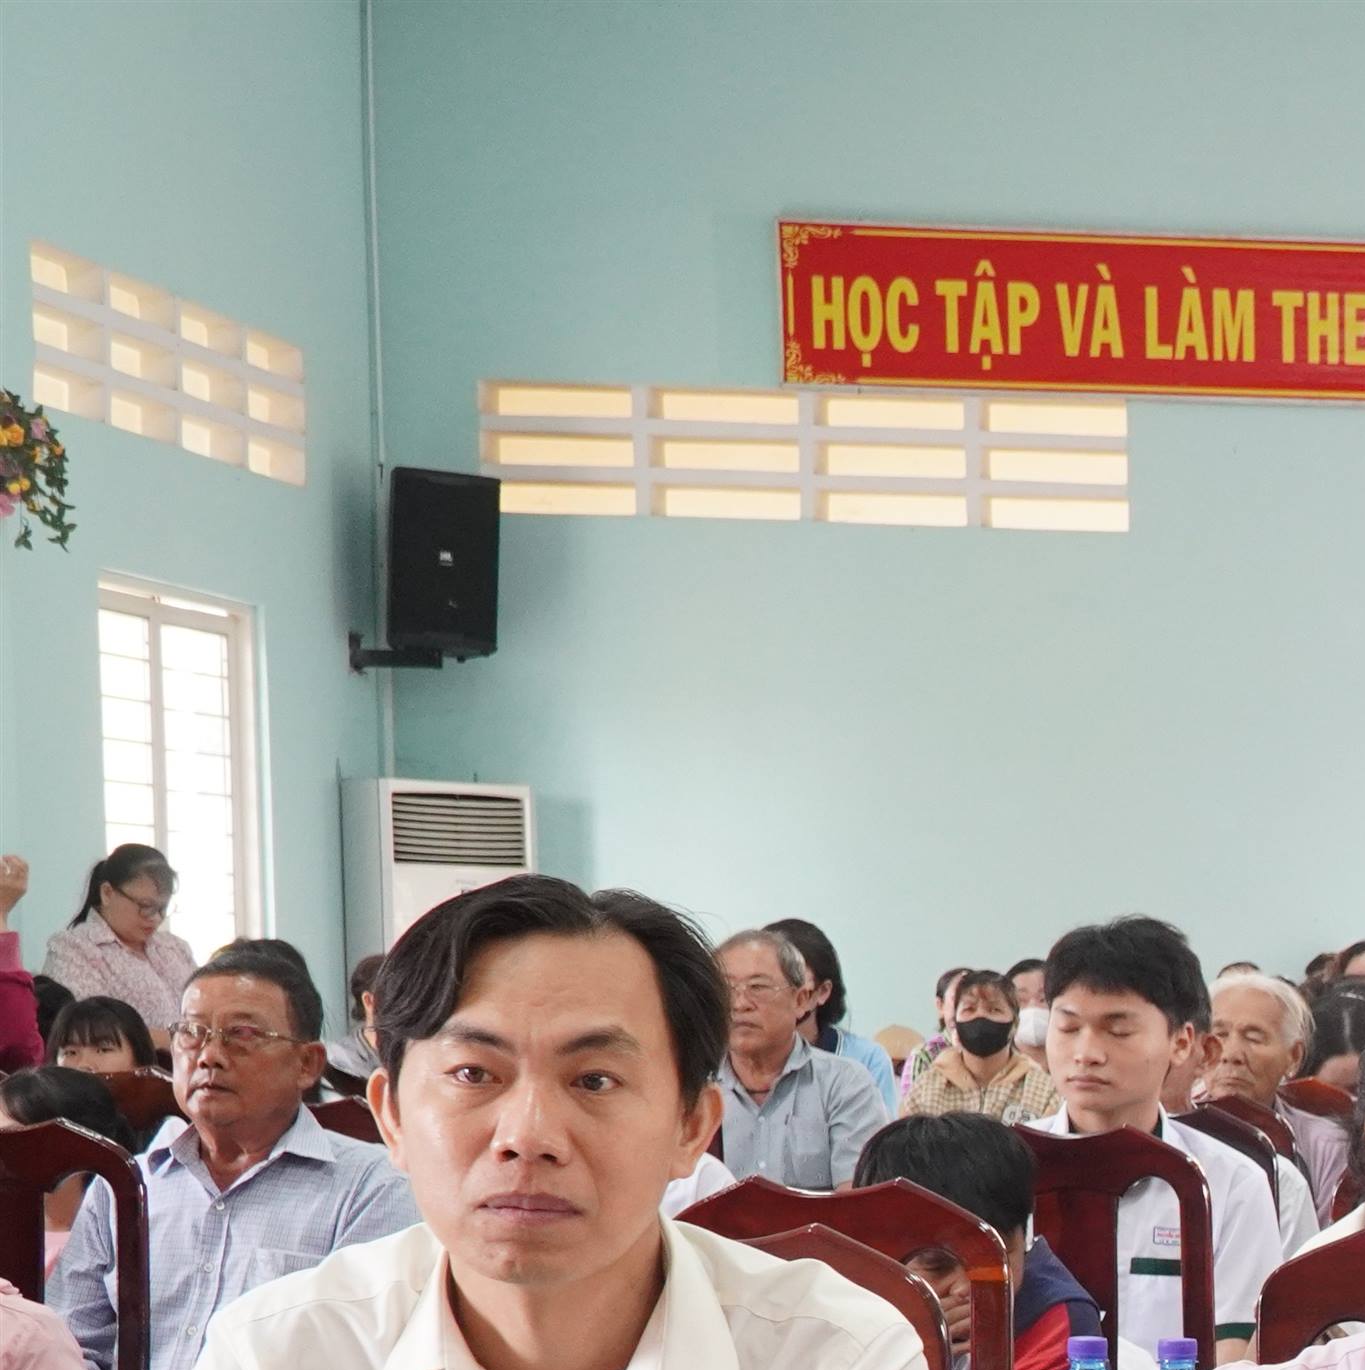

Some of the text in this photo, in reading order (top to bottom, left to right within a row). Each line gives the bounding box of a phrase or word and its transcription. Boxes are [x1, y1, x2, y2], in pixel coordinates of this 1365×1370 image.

[811, 274, 920, 367] HỌC
[935, 259, 1040, 370] TẬP
[1056, 264, 1125, 359] VÀ
[1145, 266, 1256, 361] LÀM
